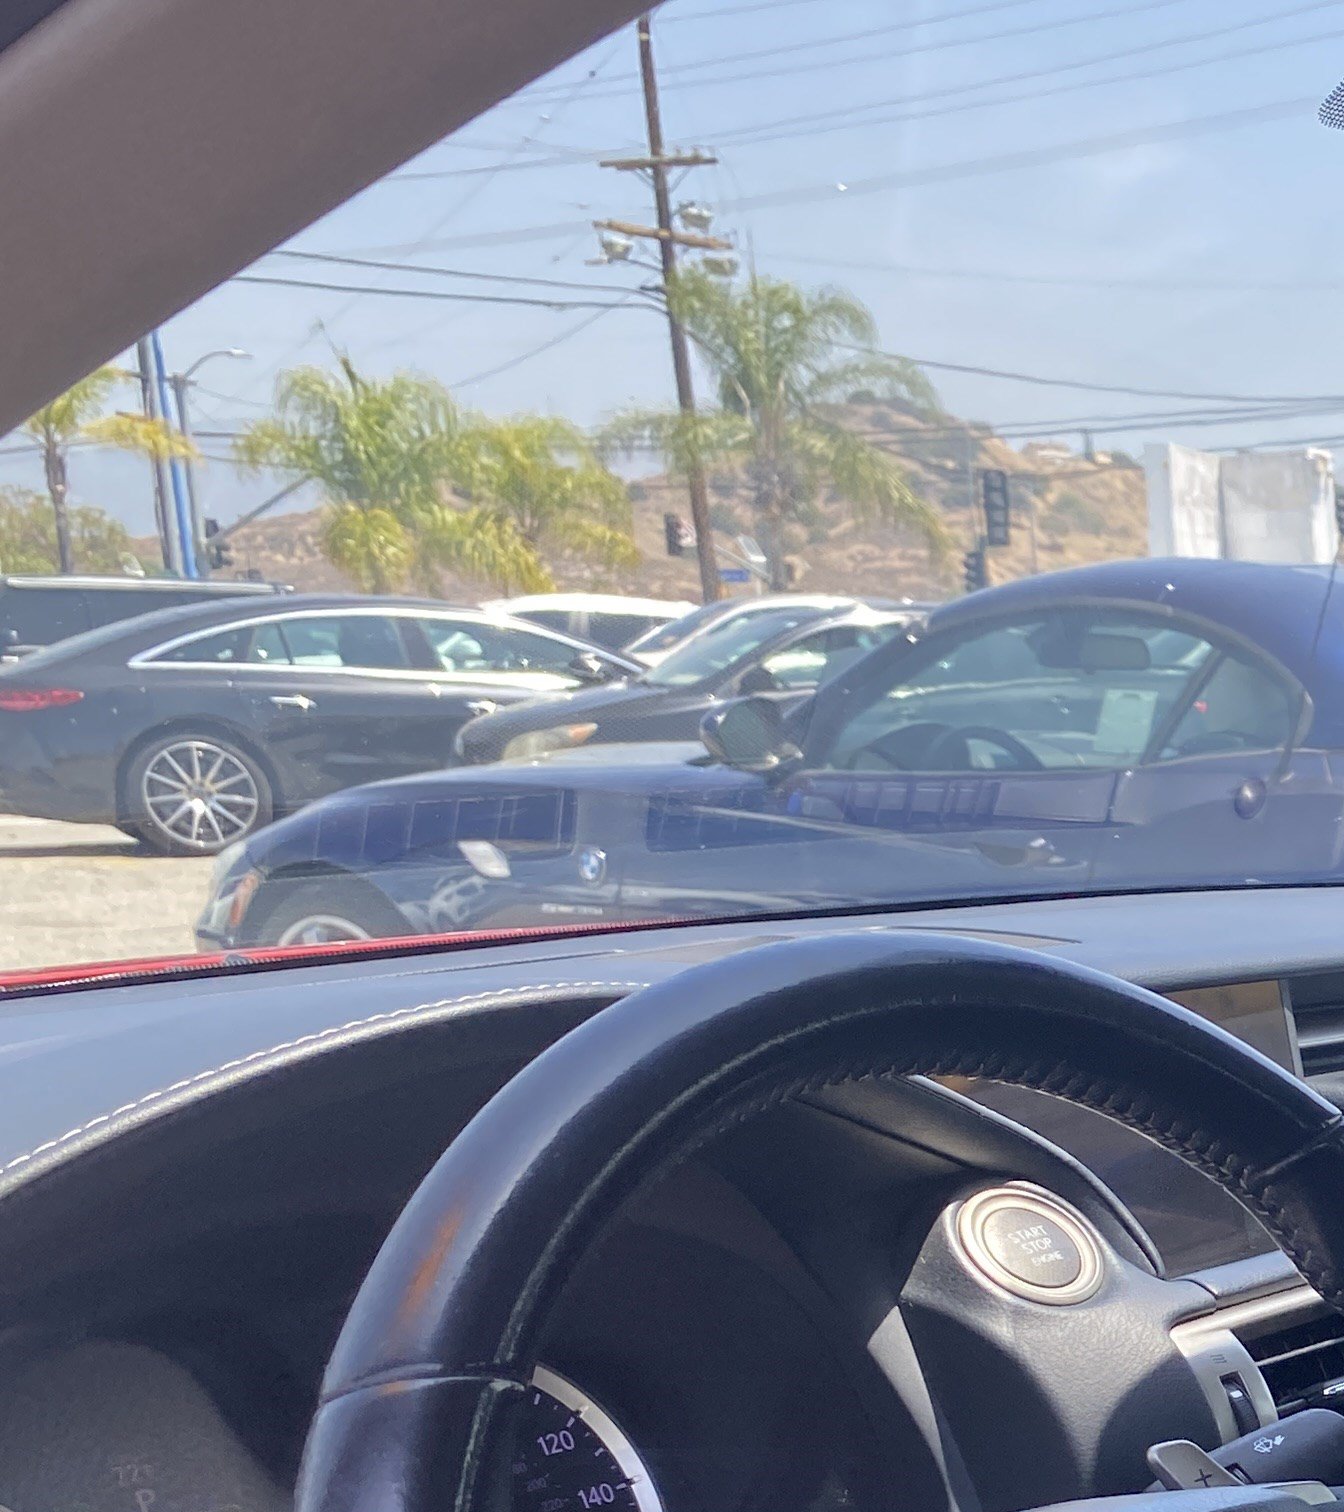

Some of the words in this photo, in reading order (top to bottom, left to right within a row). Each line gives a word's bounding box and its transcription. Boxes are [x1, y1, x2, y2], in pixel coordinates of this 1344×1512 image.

[1007, 1225, 1048, 1244] START
[1021, 1237, 1052, 1255] STOP
[537, 1430, 575, 1456] 120
[577, 1483, 615, 1509] 140
